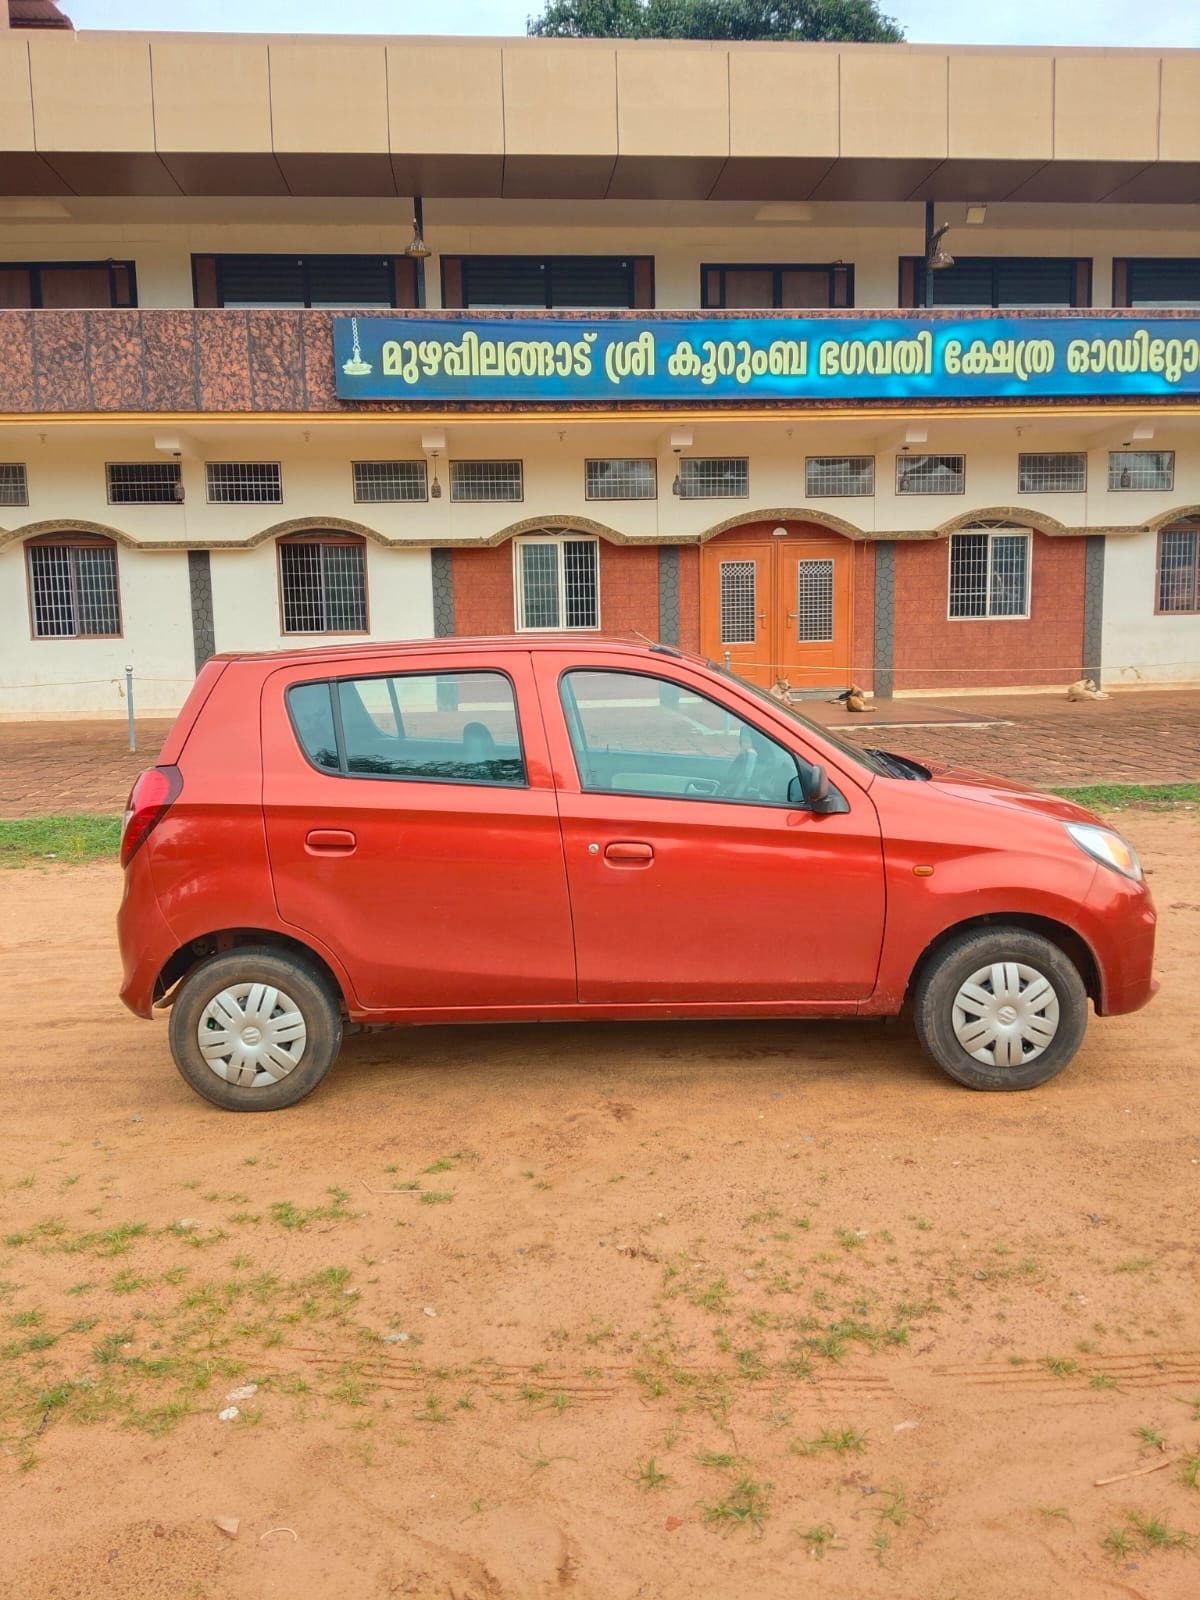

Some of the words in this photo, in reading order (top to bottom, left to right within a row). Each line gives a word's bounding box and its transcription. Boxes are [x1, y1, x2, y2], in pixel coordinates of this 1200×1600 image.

[383, 331, 597, 384] മുഴപ്പിലങ്ങാട്
[605, 331, 654, 384] ശ്രീ
[668, 340, 807, 384] കൂറുംബ
[820, 330, 932, 375] ഭഗവതി
[945, 339, 1054, 381] ക്ഷേത്ര
